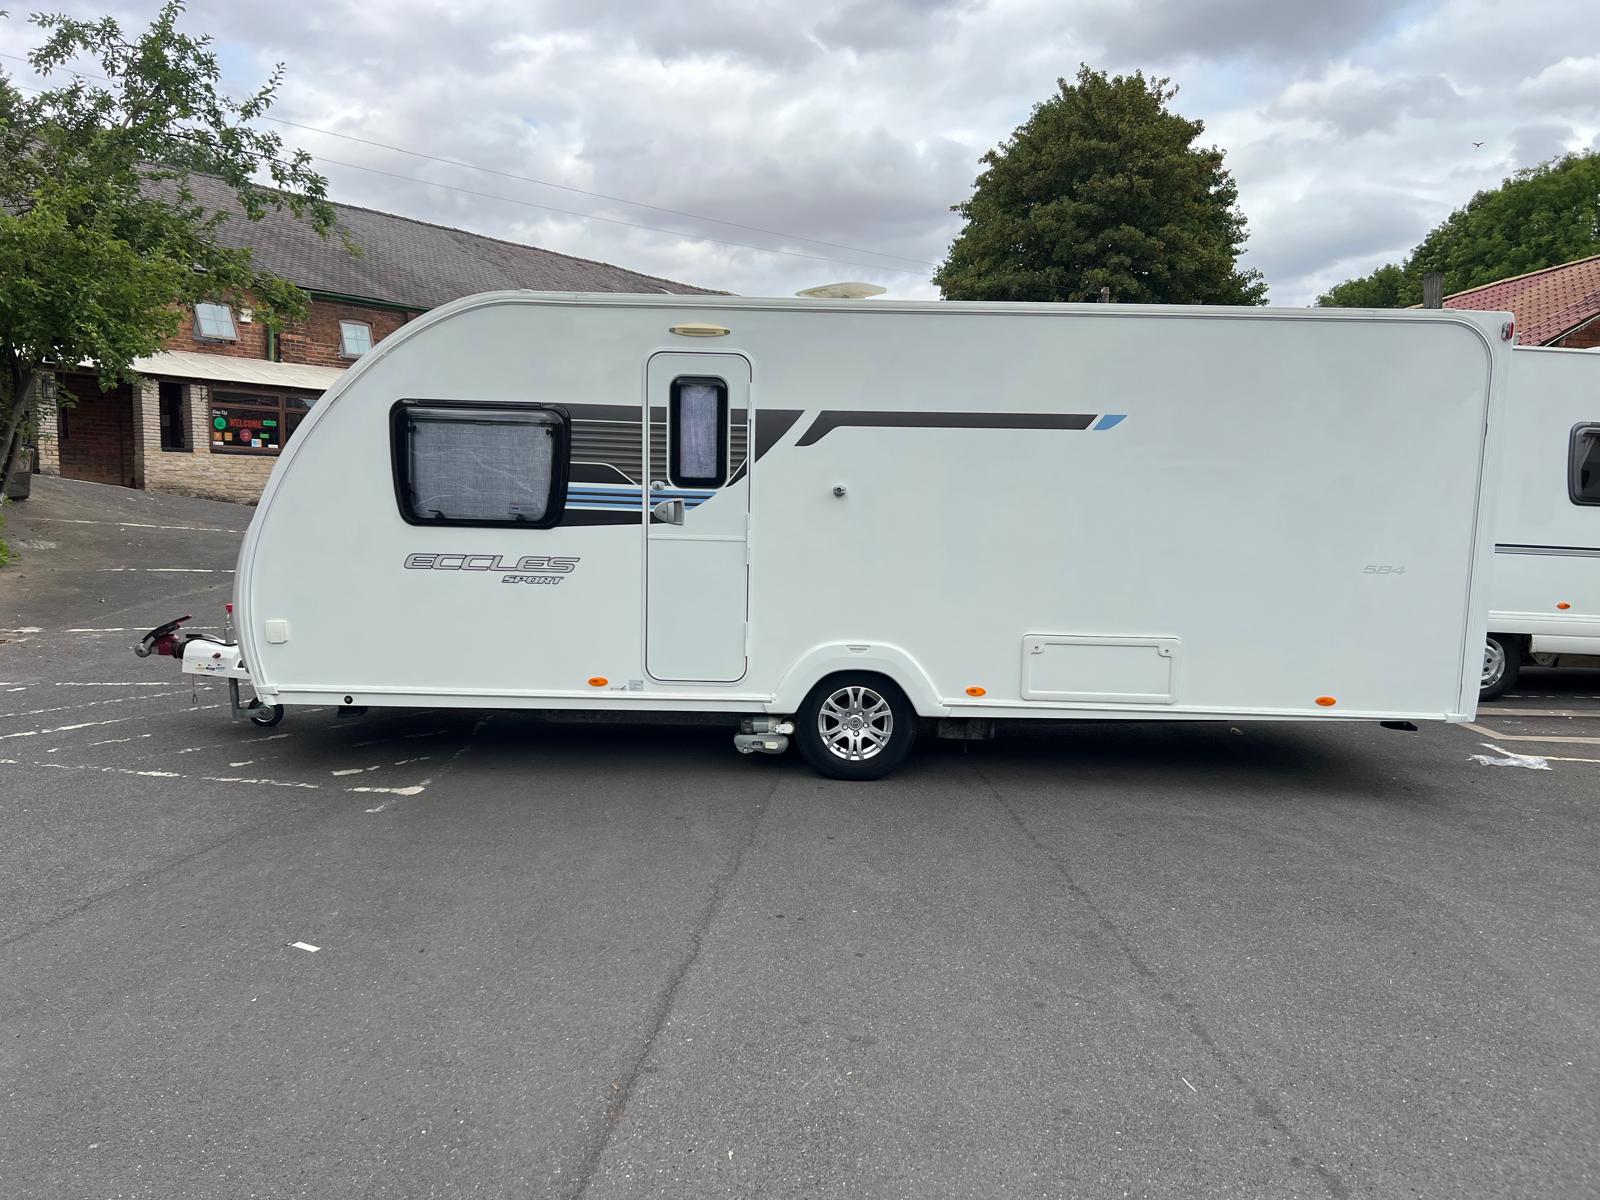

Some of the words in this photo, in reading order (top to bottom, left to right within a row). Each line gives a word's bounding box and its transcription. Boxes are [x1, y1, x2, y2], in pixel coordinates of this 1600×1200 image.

[229, 418, 262, 428] WELCOME
[403, 552, 581, 573] ECCLES
[1362, 565, 1406, 575] 584
[501, 574, 565, 585] SPORT
